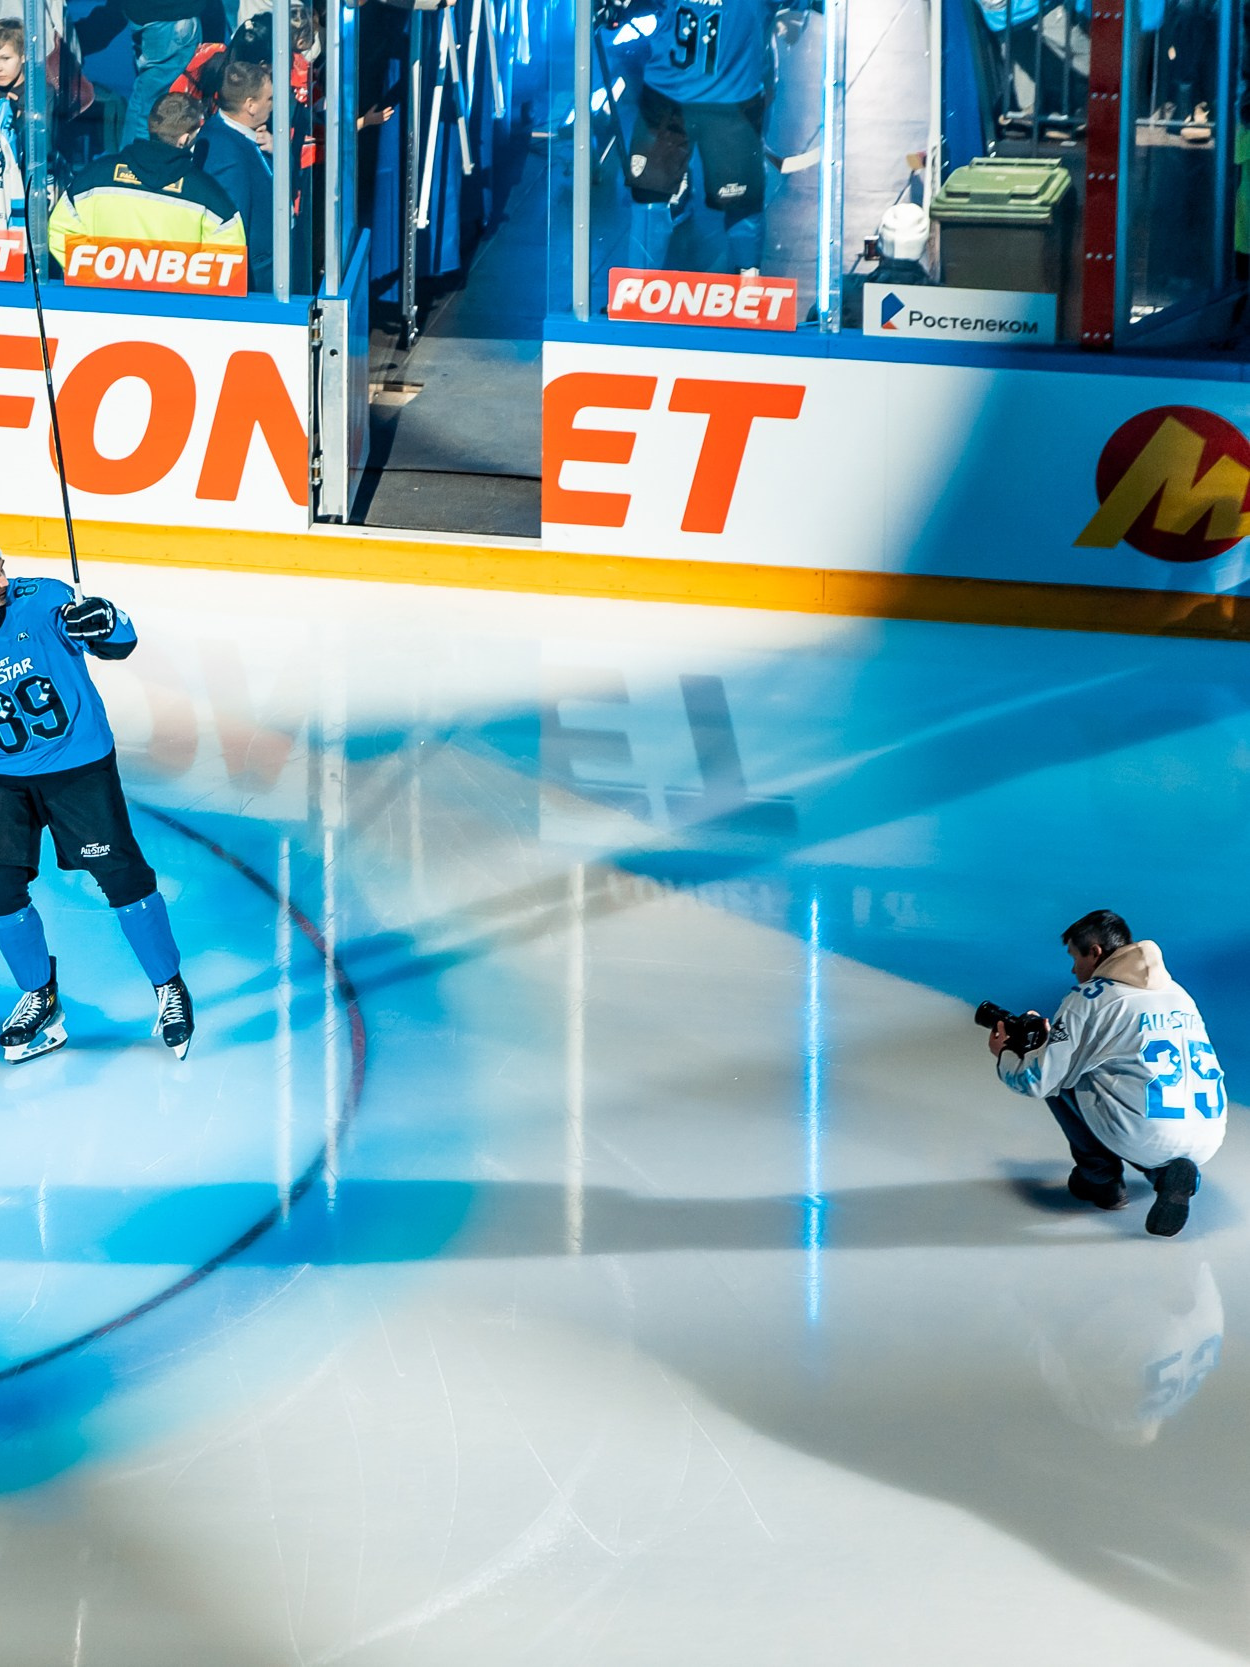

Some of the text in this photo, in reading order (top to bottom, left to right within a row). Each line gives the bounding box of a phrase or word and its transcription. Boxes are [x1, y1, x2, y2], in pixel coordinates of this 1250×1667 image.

[670, 6, 722, 76] 91
[67, 244, 244, 287] FONBET
[611, 278, 794, 321] FONBET
[908, 310, 1039, 334] Ростелеком
[1140, 1038, 1225, 1120] 25
